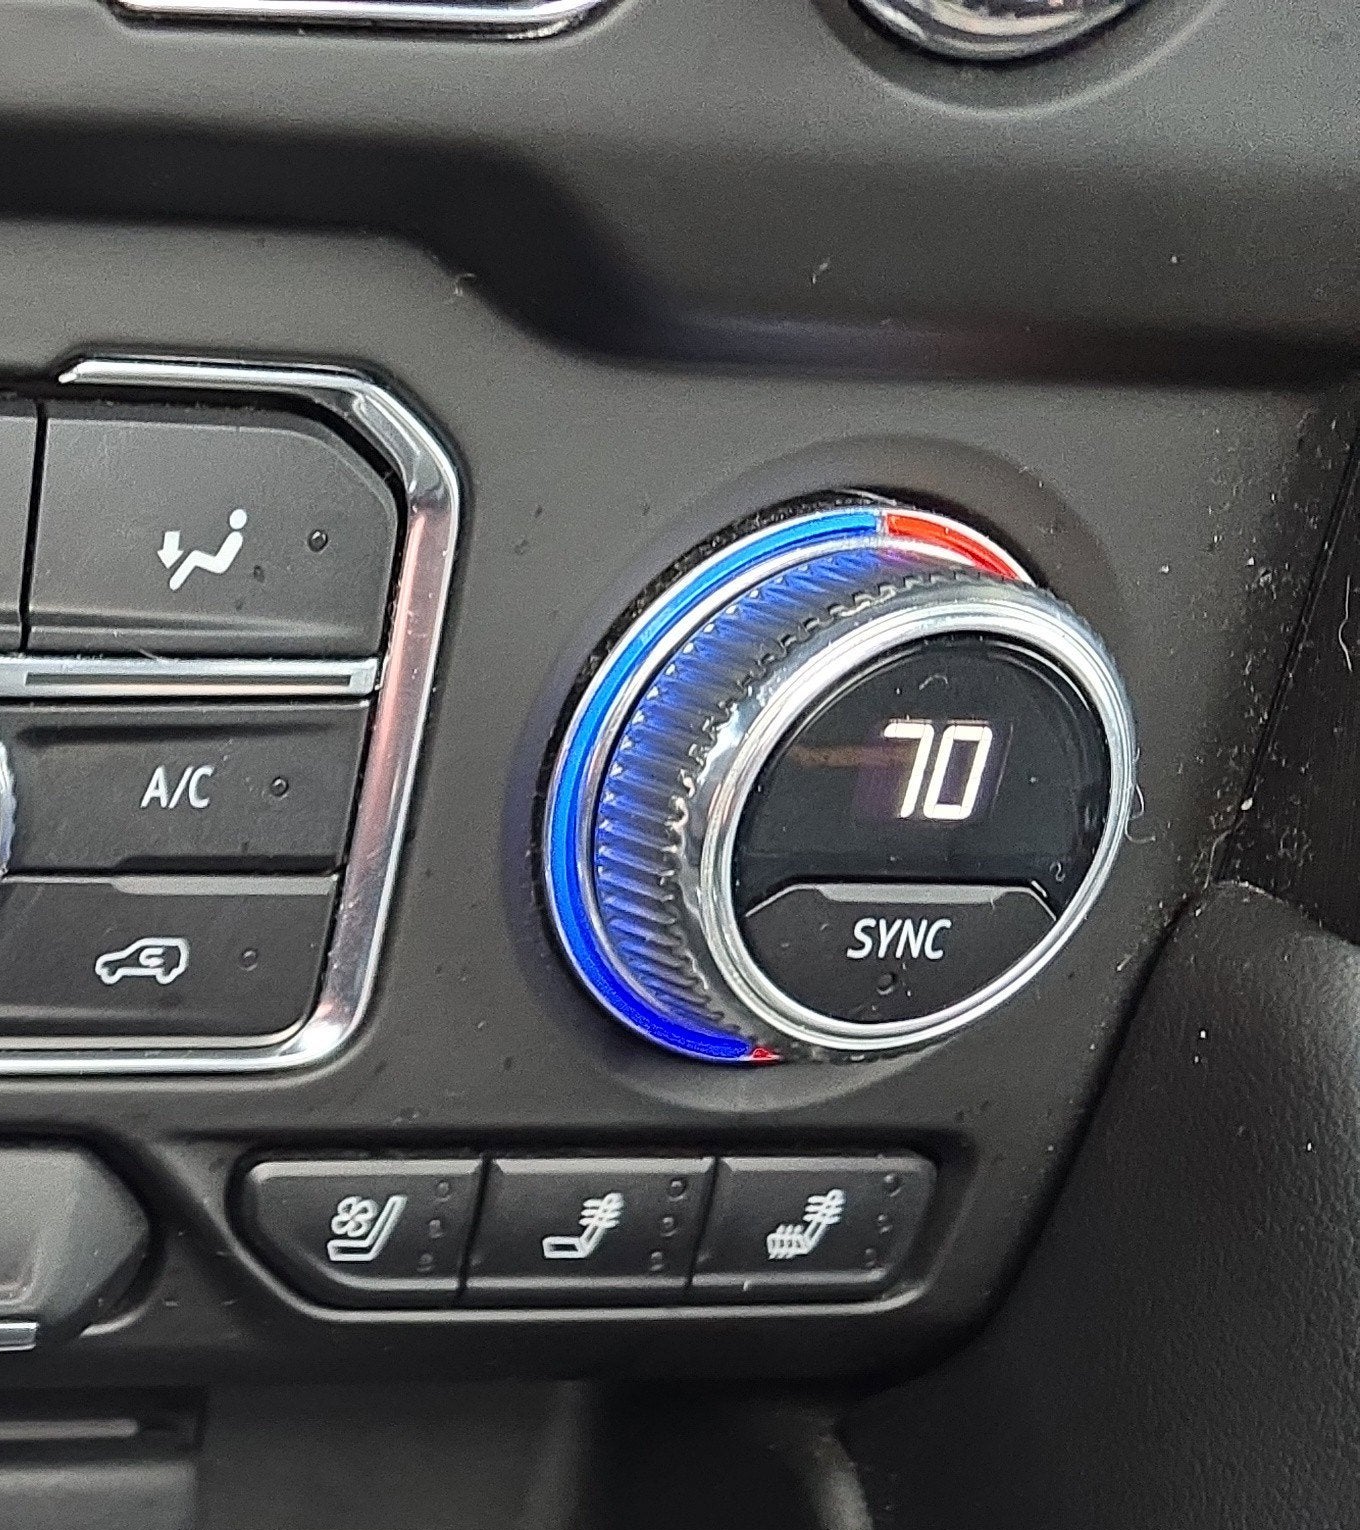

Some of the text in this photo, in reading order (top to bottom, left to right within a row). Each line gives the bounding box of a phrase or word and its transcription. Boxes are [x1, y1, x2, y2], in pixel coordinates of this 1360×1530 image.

[140, 764, 215, 810] A/C
[882, 721, 994, 820] 70
[846, 917, 953, 961] SYNC
